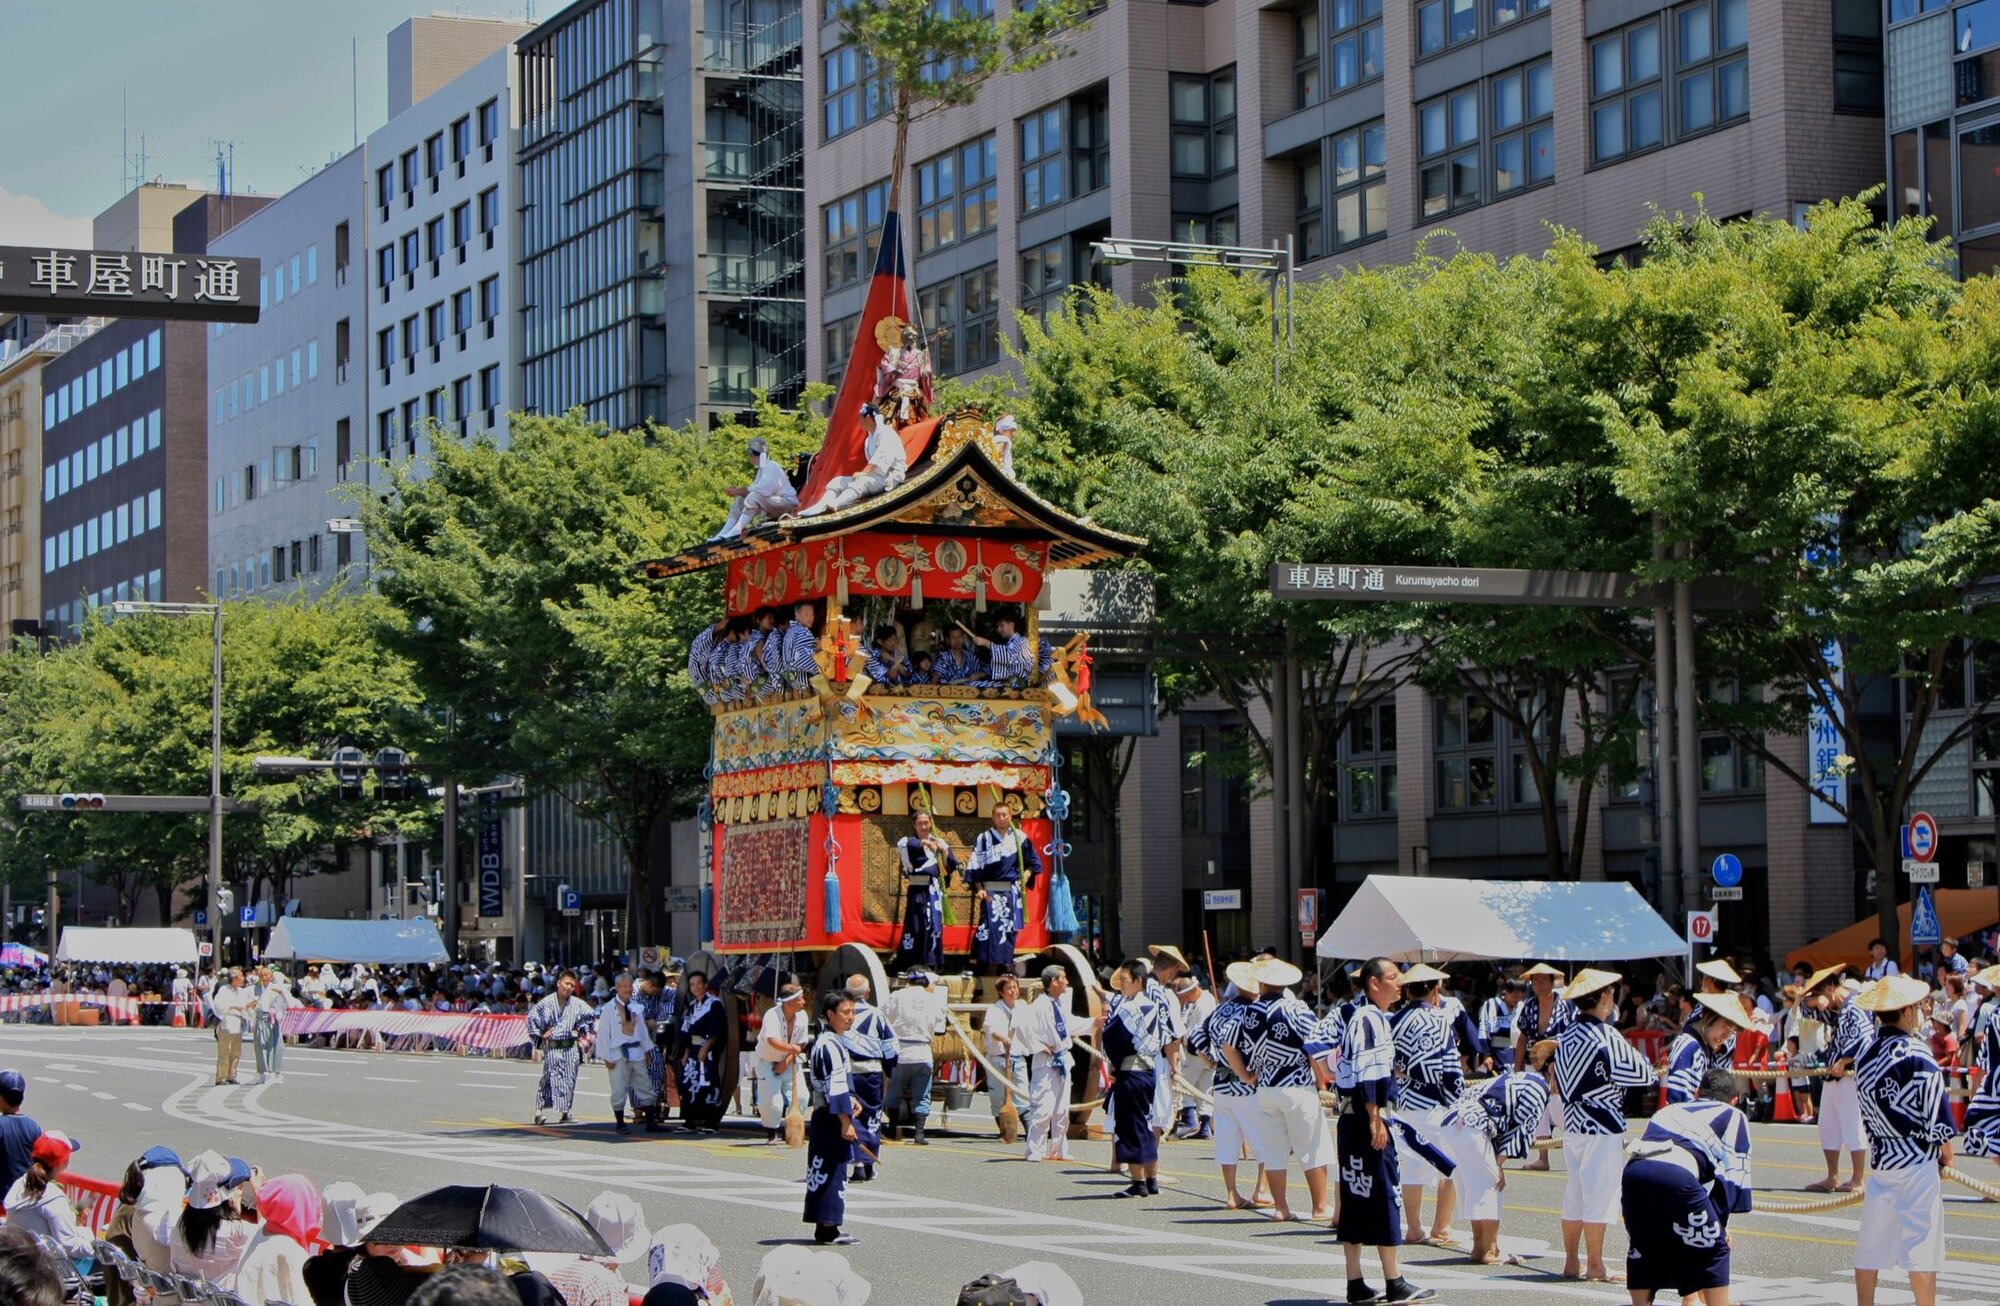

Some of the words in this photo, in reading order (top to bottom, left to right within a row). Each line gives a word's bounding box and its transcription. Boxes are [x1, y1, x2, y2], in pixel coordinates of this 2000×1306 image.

[30, 251, 241, 302] 車屋町通
[1287, 565, 1385, 591] 車屋町通
[1395, 574, 1459, 588] Kurumayacho
[1461, 576, 1480, 587] dori
[481, 853, 500, 909] WDB
[567, 893, 577, 907] P
[244, 908, 253, 921] P
[1695, 919, 1708, 935] 17
